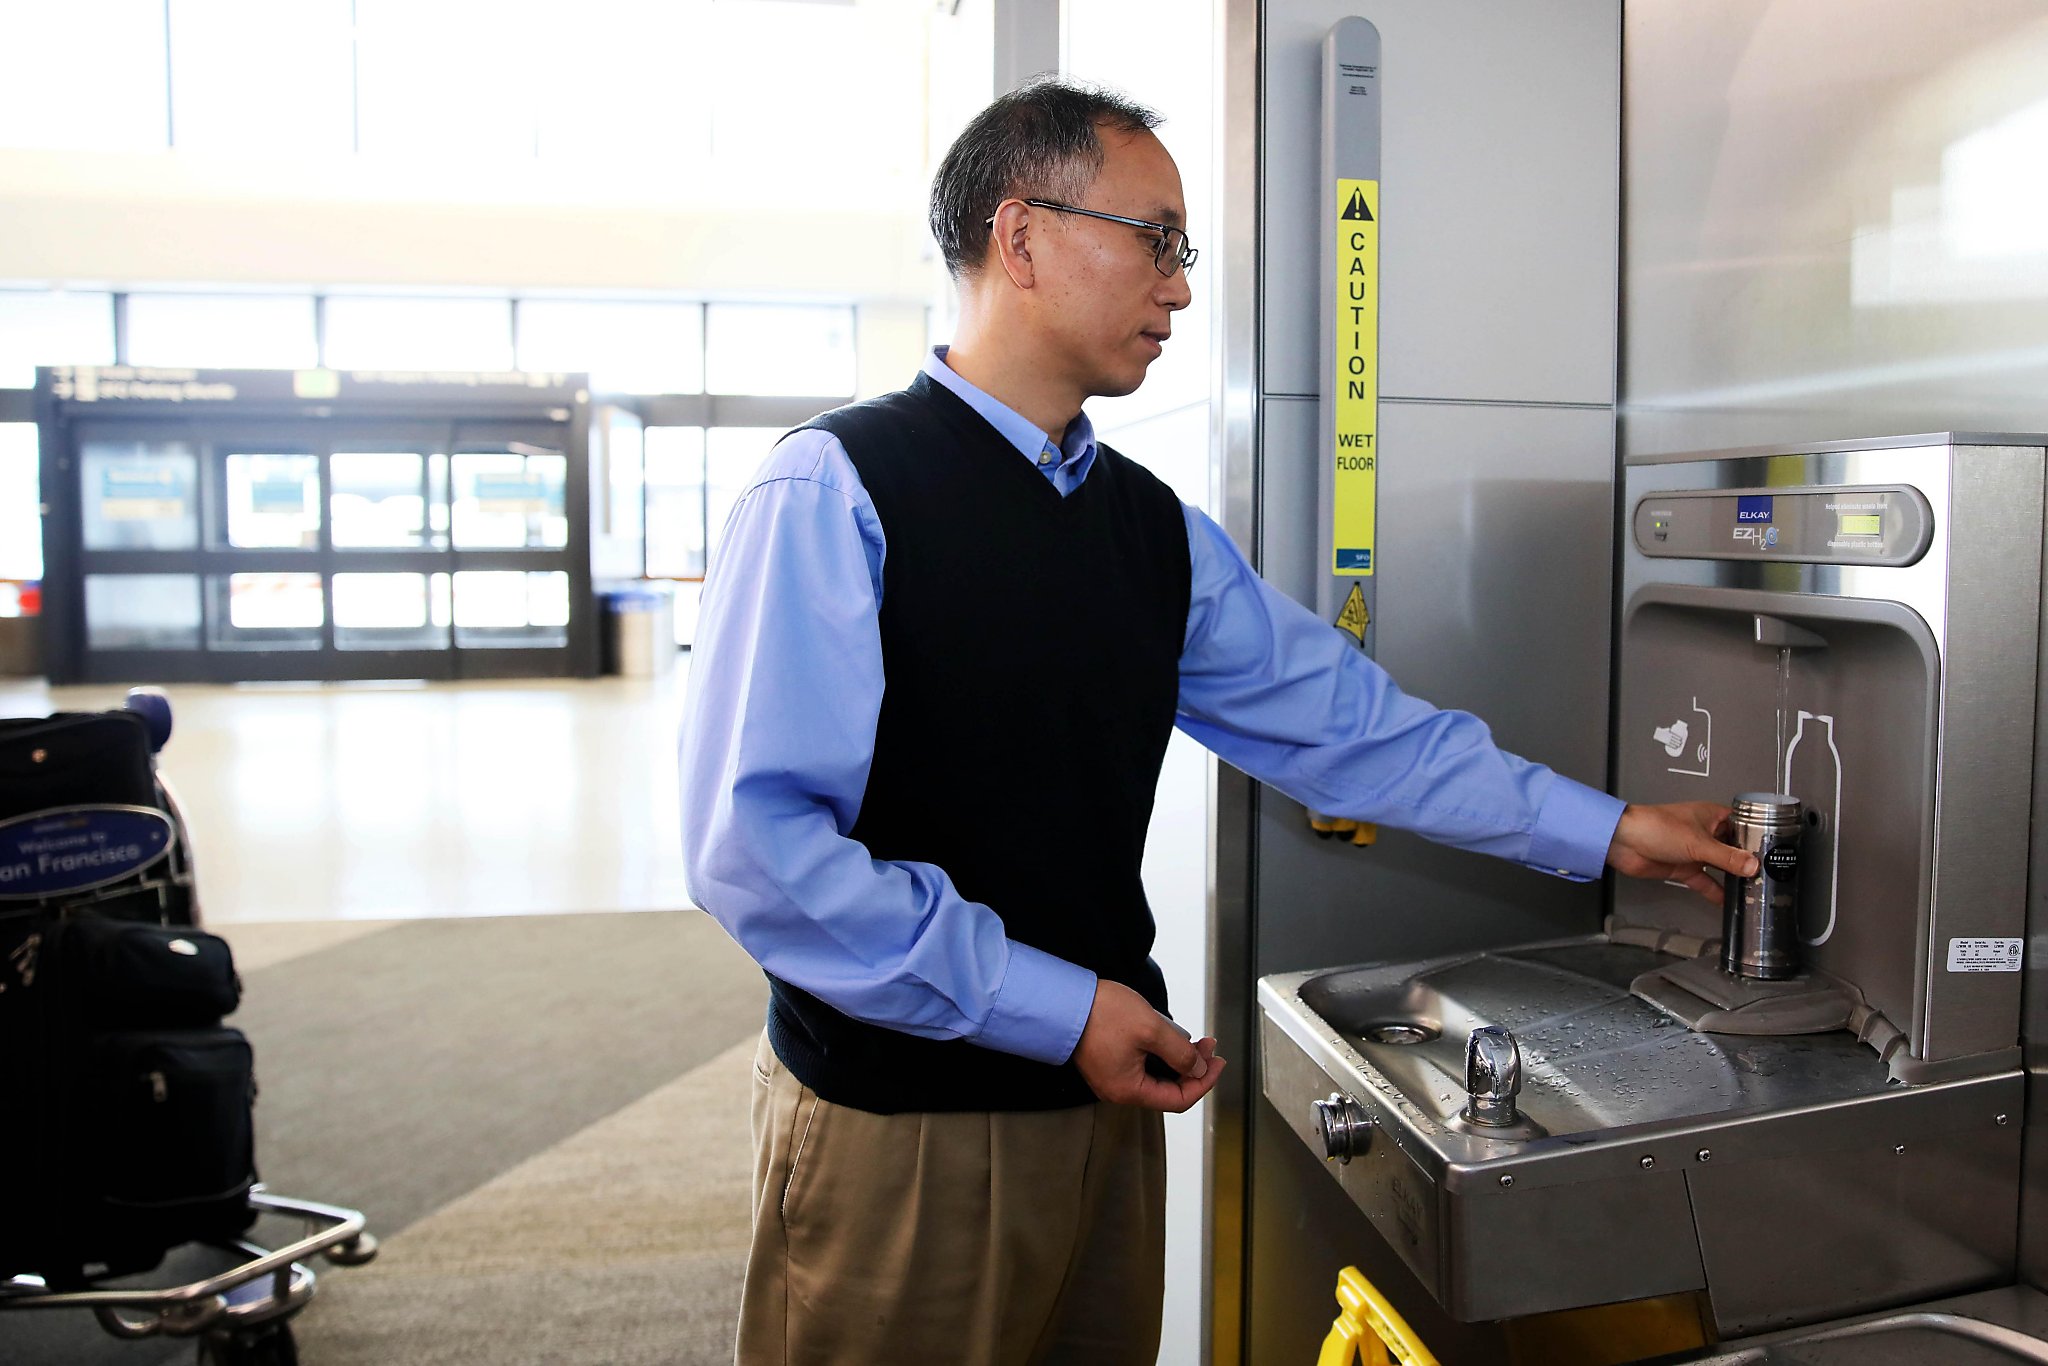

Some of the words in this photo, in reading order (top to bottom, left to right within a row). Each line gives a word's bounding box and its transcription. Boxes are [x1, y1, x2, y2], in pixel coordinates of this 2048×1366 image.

[1348, 232, 1365, 400] CAUTION
[1338, 434, 1373, 448] WET
[1337, 456, 1374, 471] FLOOR
[1740, 511, 1770, 519] ELKAY
[18, 834, 88, 853] Welcome
[90, 831, 106, 844] to
[0, 860, 31, 882] an
[37, 844, 140, 874] Francisco
